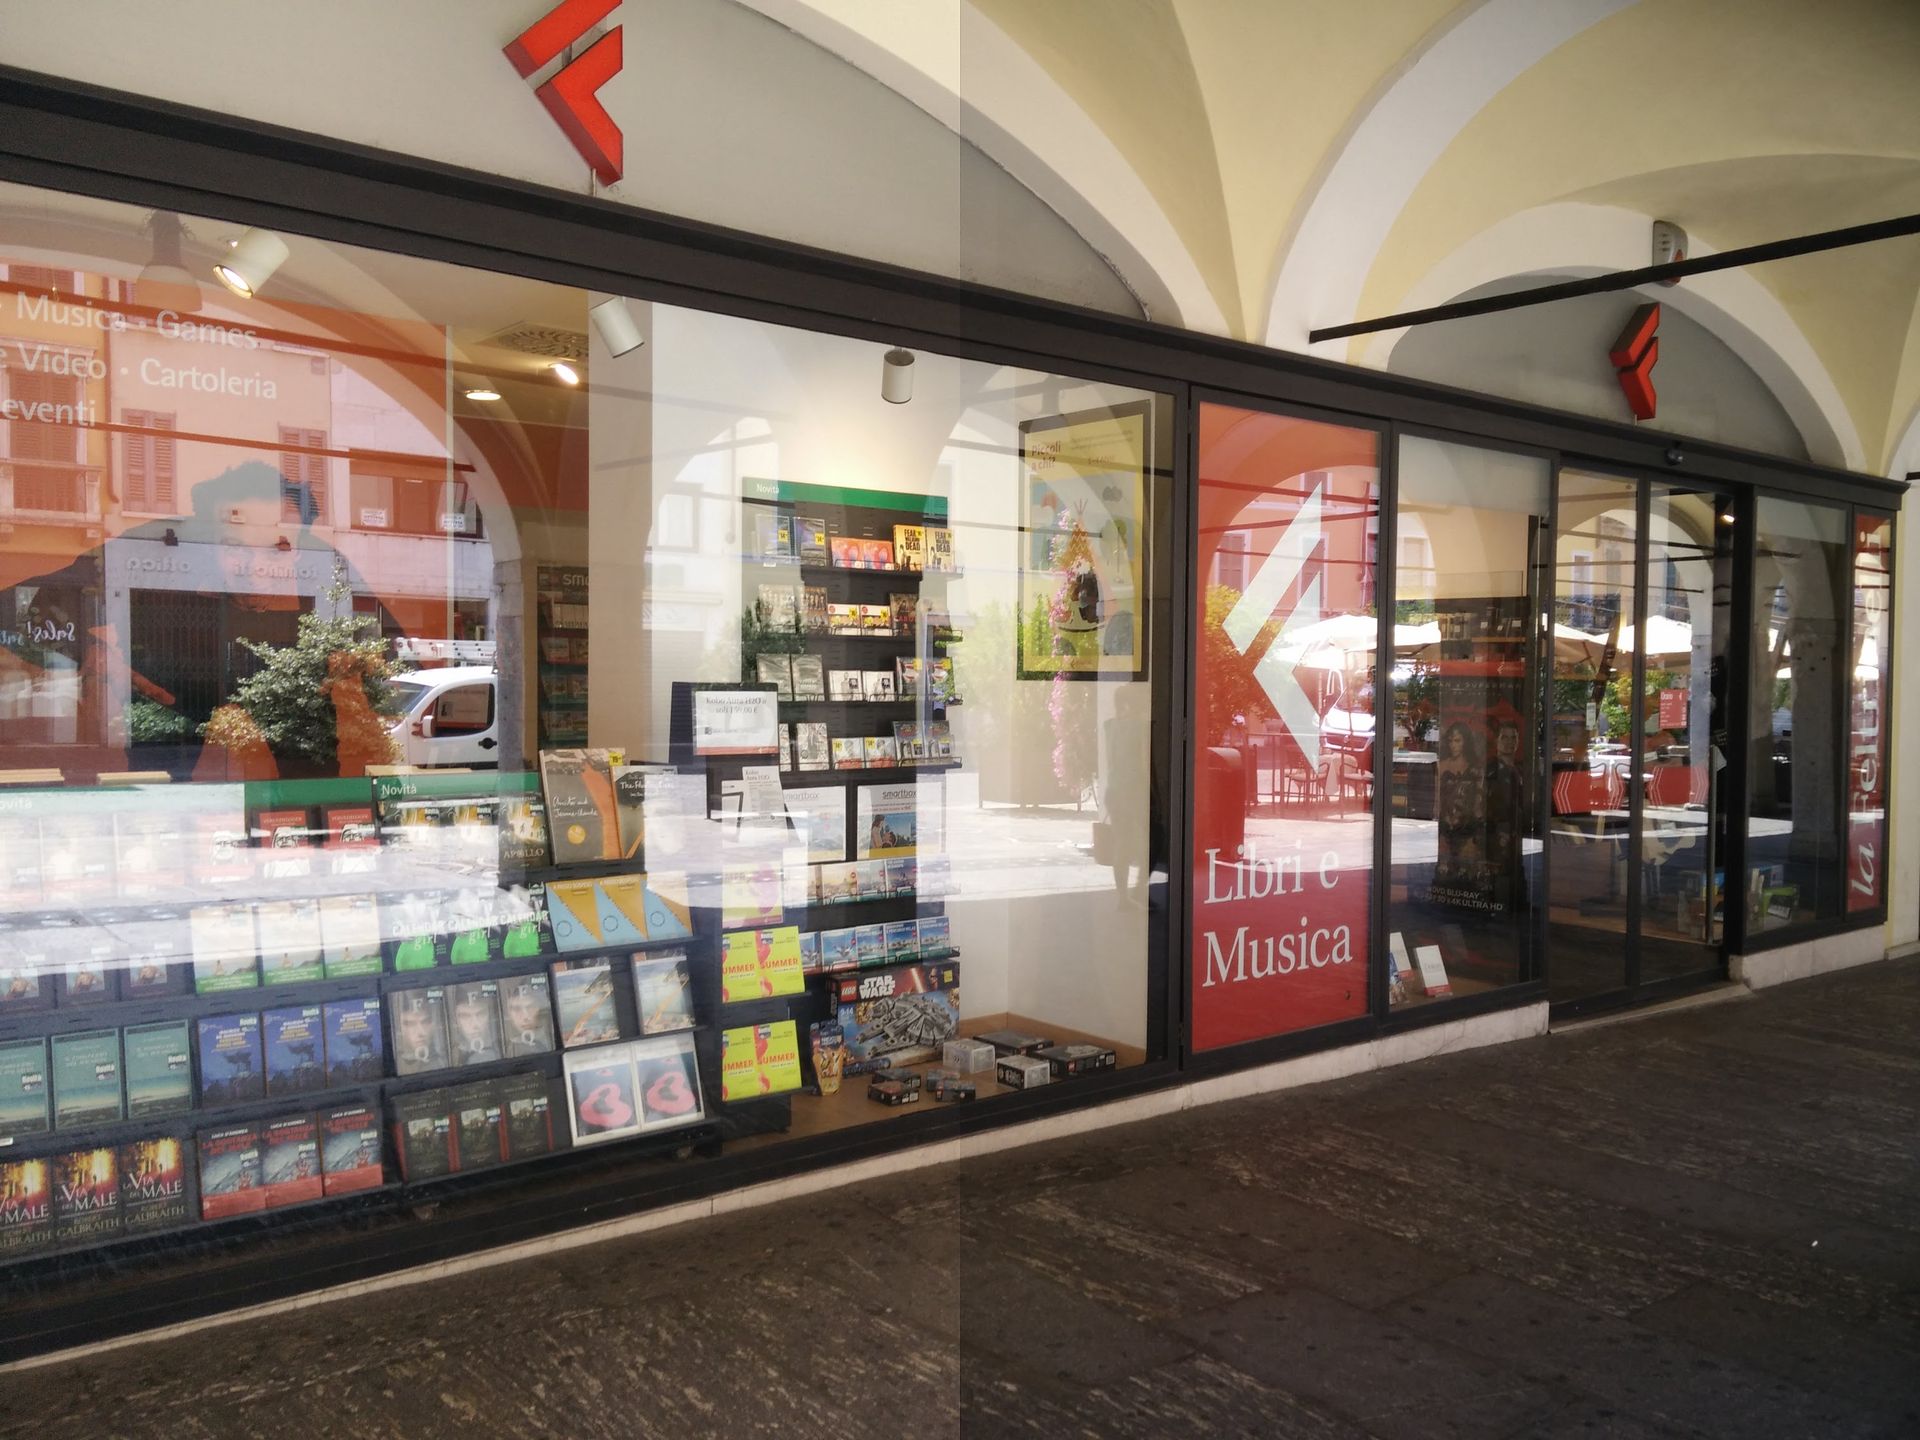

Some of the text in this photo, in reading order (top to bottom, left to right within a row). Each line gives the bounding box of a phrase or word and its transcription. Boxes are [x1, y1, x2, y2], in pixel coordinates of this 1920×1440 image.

[16, 290, 259, 351] Musica Games
[17, 342, 107, 380] Video
[140, 357, 278, 400] Cartoleria
[3, 399, 96, 427] eventi
[905, 541, 921, 552] DEAD
[1852, 531, 1883, 831] Feltrielli
[0, 797, 33, 810] ovità
[1204, 838, 1340, 905] Libri e
[1851, 842, 1875, 897] la
[1447, 888, 1480, 900] BLU-RAY
[1462, 899, 1489, 910] ULTRA
[1489, 902, 1503, 911] HD
[1202, 915, 1353, 988] Musica
[722, 963, 755, 976] UMMER
[759, 957, 799, 970] SUMMER
[840, 986, 857, 997] LEGO
[858, 983, 896, 1000] WARS
[863, 974, 894, 989] STAR
[129, 1171, 155, 1190] VIA
[141, 1178, 184, 1200] MALE
[61, 1183, 89, 1202] VIA
[74, 1190, 118, 1212] MALE
[4, 1203, 50, 1224] MALE
[124, 1204, 186, 1226] GALBRAITH
[56, 1216, 120, 1238] GALBRAITH
